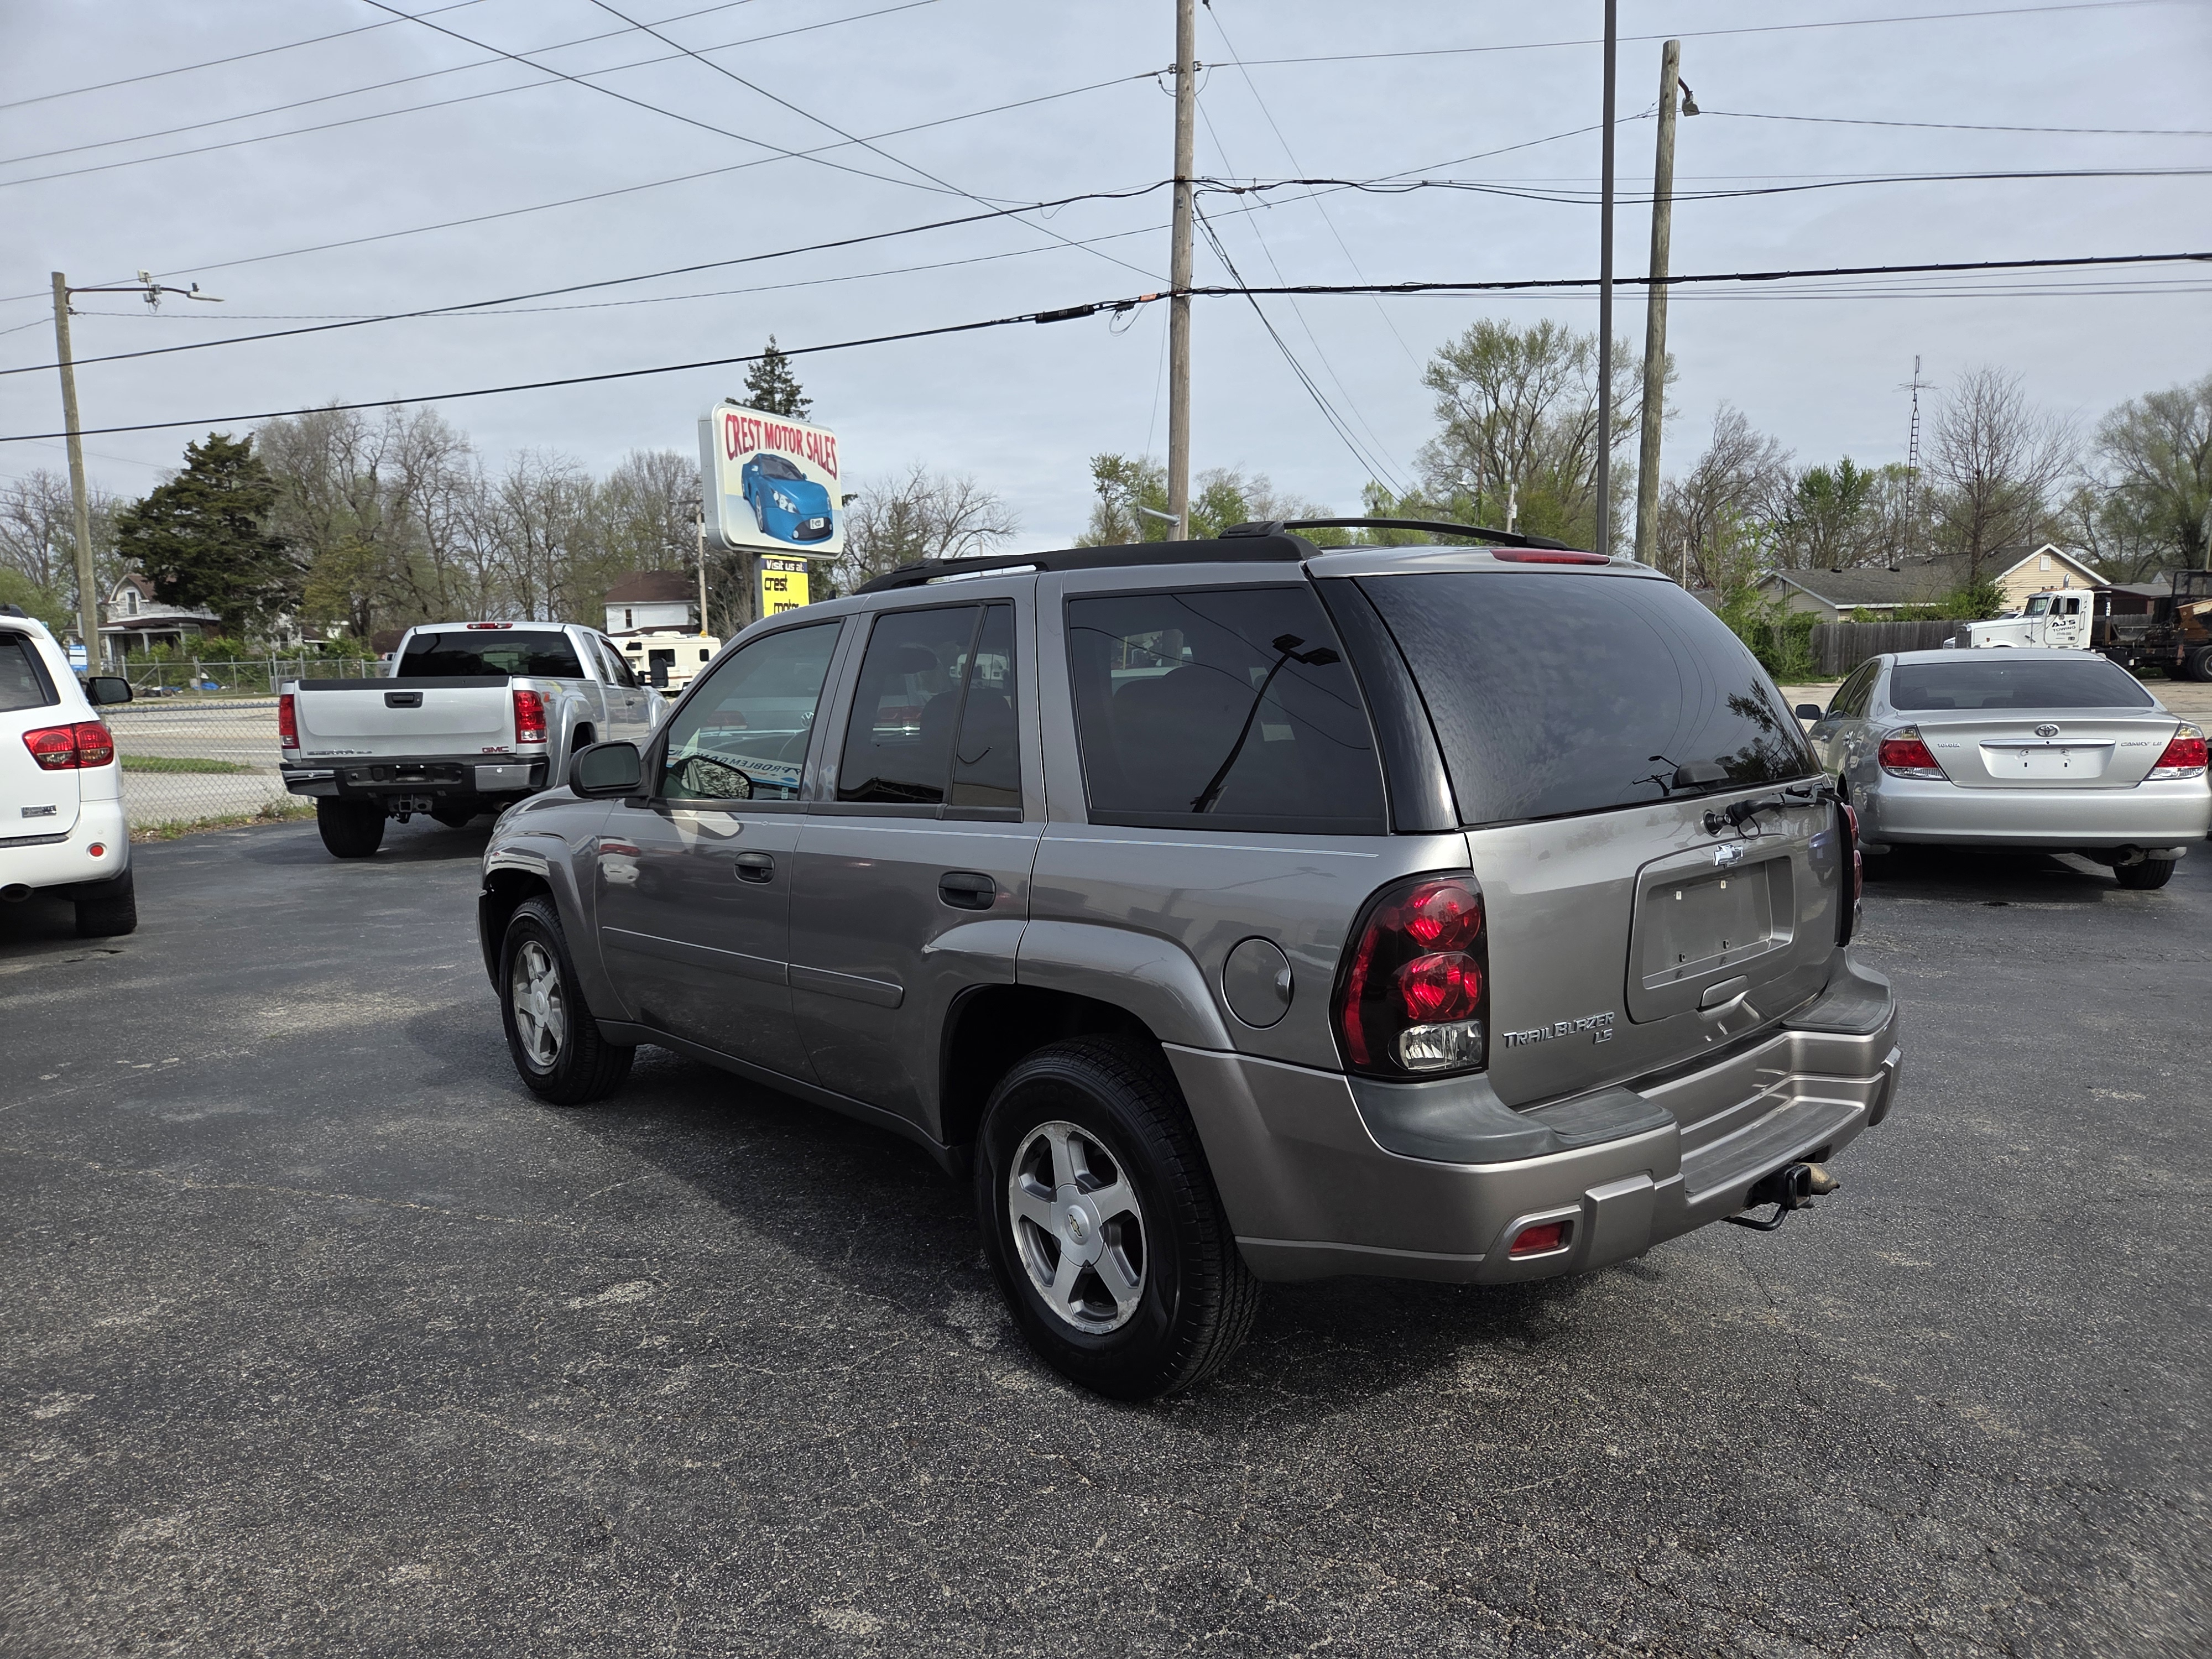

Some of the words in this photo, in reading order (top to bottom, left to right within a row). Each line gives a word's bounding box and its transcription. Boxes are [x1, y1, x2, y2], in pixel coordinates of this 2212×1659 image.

[726, 413, 761, 461] CREST
[764, 422, 805, 457] MOTOR
[807, 431, 837, 481] SALES
[766, 560, 784, 570] Visit
[764, 574, 787, 592] crest
[2052, 619, 2076, 628] AJ'S
[1593, 1029, 1613, 1045] LS
